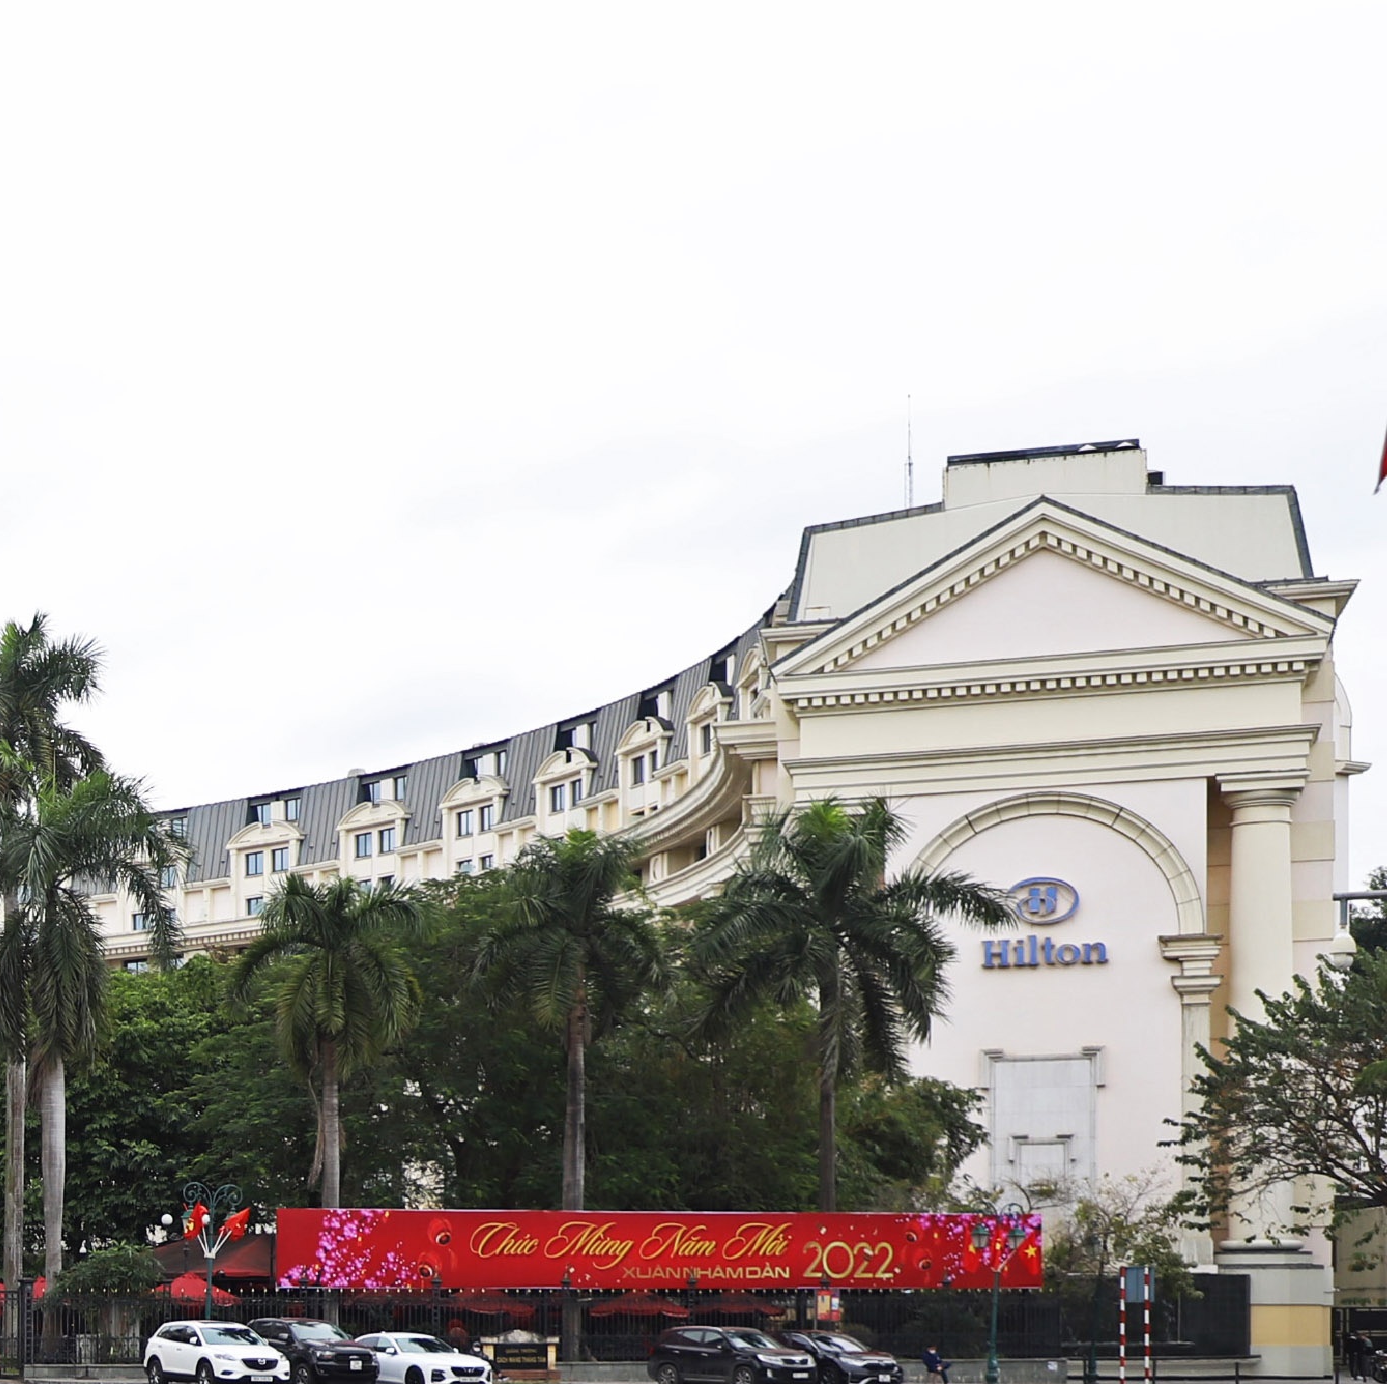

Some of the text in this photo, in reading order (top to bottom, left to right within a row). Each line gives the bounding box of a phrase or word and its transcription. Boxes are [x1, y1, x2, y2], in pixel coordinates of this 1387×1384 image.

[981, 934, 1109, 969] Hilton
[470, 1221, 793, 1270] Chúc Mừng Năm Mới
[803, 1241, 894, 1279] 2022
[623, 1264, 681, 1279] XUÂN
